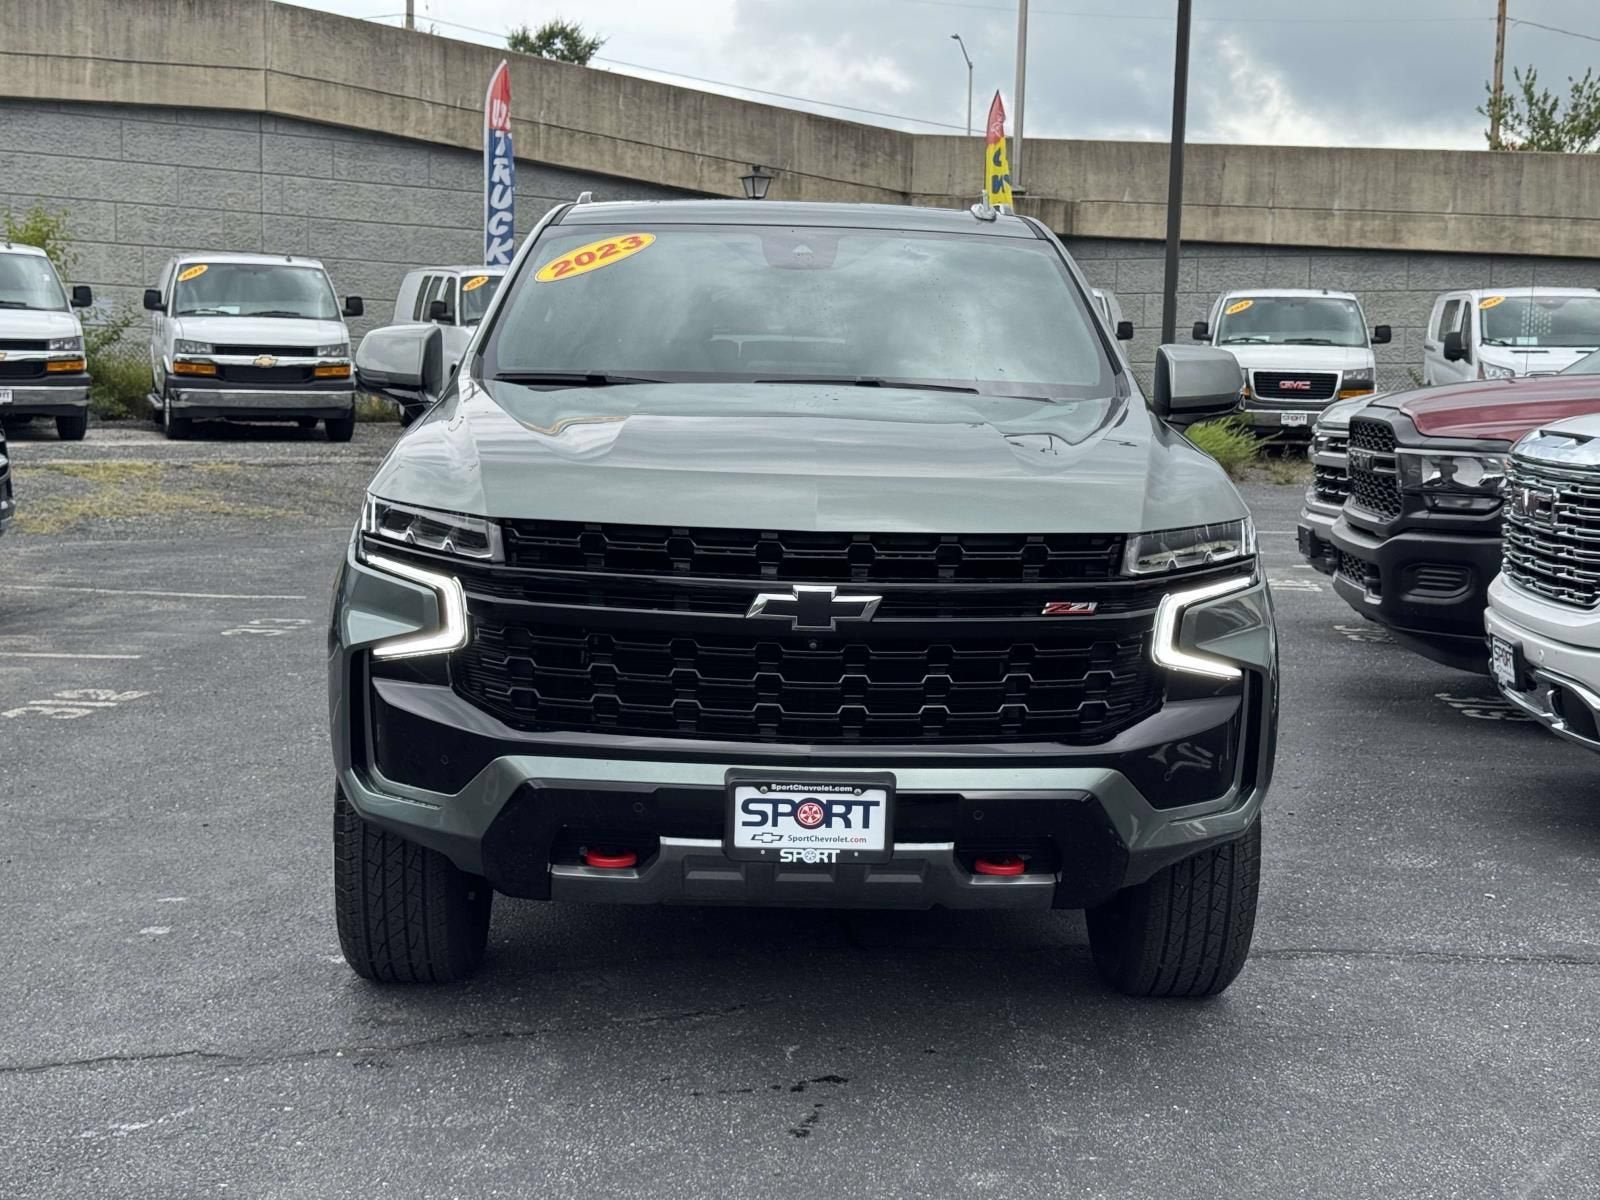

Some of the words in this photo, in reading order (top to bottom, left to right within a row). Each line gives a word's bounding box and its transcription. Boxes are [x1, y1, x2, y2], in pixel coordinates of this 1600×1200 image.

[551, 237, 643, 278] 2023
[1279, 380, 1311, 390] GMC
[1041, 602, 1098, 615] Z71
[770, 783, 853, 793] SportChevrolet.com
[741, 797, 880, 830] SPORT
[787, 834, 867, 844] SportChevrolet.com
[780, 848, 840, 864] SPORT
